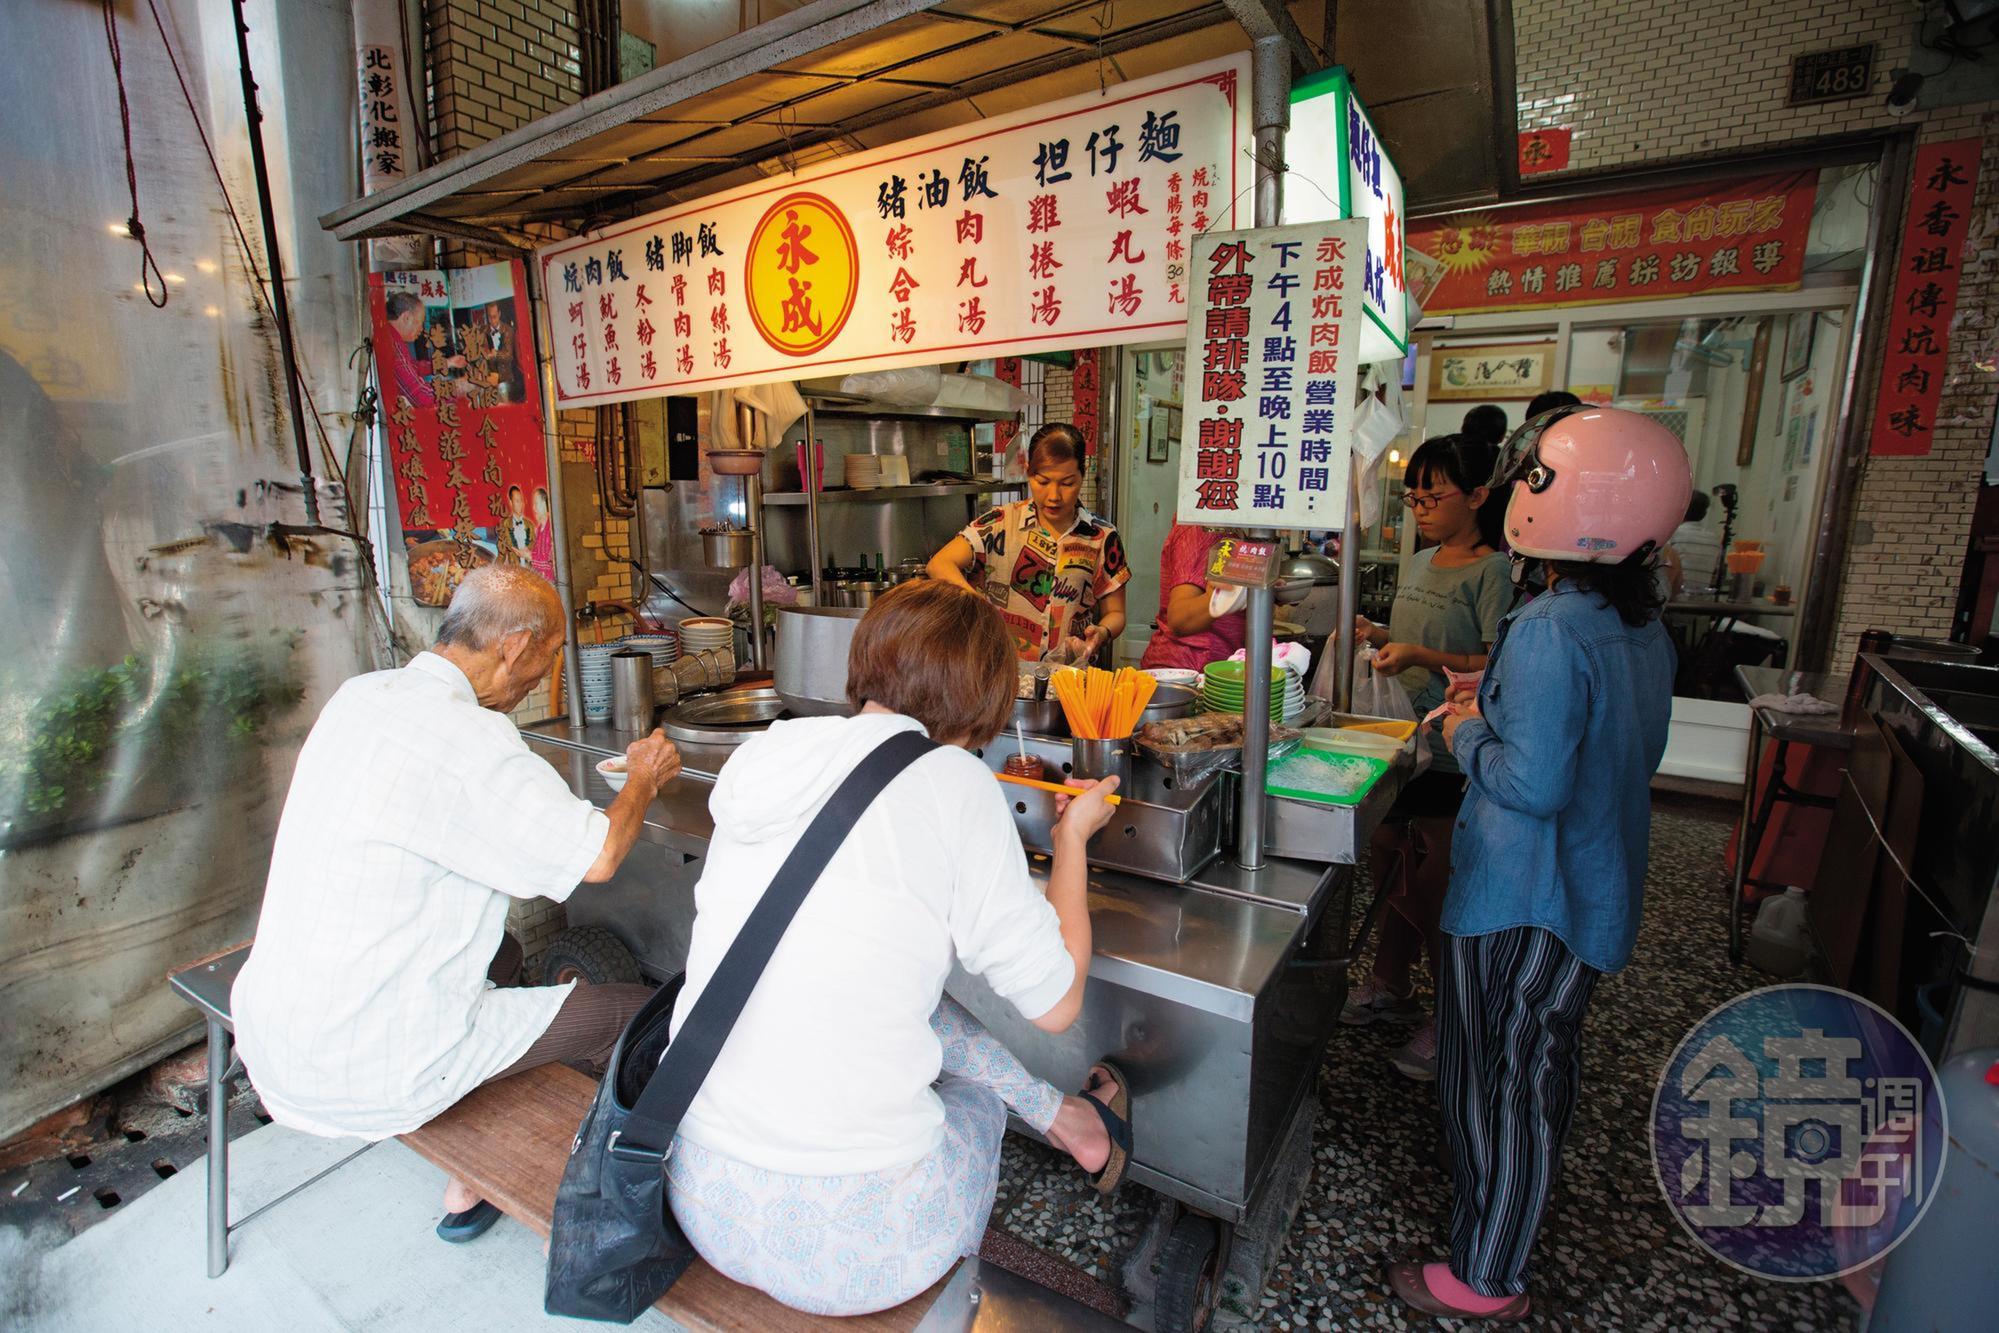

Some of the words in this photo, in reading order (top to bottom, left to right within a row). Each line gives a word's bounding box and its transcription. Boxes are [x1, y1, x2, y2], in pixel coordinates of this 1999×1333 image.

[367, 48, 403, 175] 北彰化搬家
[1816, 65, 1865, 93] 483
[877, 156, 999, 220] 豬油飯
[1033, 110, 1184, 188] 担仔麵
[776, 210, 822, 337] 永成
[956, 209, 988, 336] 肉丸湯
[1026, 193, 1063, 326] 雞捲湯
[1106, 176, 1149, 317] 蝦丸湯
[1486, 240, 1787, 297] 熱情推薦採訪報導
[1512, 222, 1571, 257] 華視
[1581, 214, 1643, 253] 台視
[1650, 195, 1787, 245] 食尚玩家
[635, 284, 656, 380] 冬粉湯
[671, 273, 695, 375] 骨肉湯
[707, 266, 732, 370] 肉絲湯
[885, 222, 920, 344] 綜合湯
[1889, 157, 1968, 436] 永香祖傳炕肉味
[568, 301, 590, 390] 蚵仔湯
[600, 292, 622, 386] 魷魚湯
[1253, 241, 1302, 510] 下午4點至晚上10點
